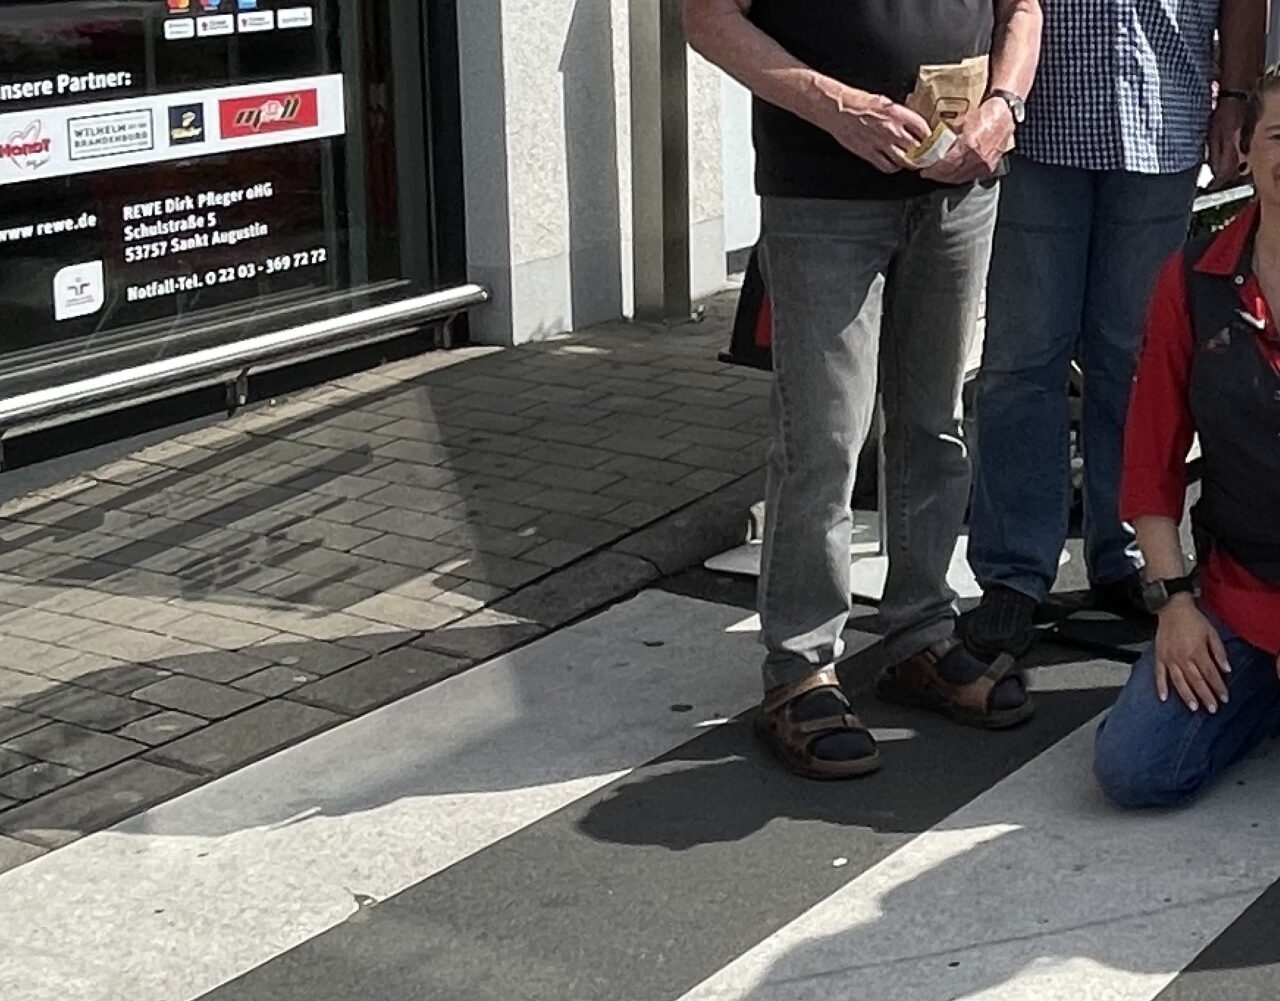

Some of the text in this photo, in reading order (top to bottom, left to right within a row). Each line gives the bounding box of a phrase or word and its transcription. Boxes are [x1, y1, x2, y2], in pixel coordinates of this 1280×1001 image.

[0, 71, 132, 100] nsere Partner:
[123, 181, 274, 221] REWE Dirk Pfleger oHG
[124, 212, 217, 242] Schulstraße 5
[125, 221, 269, 263] 53757 Sankt Augustin
[127, 273, 203, 302] Notfall-Tel.
[205, 271, 216, 285] 0
[218, 267, 235, 283] 22
[237, 263, 256, 279] 03
[266, 255, 291, 274] 369
[293, 251, 309, 267] 72
[311, 248, 327, 263] 72
